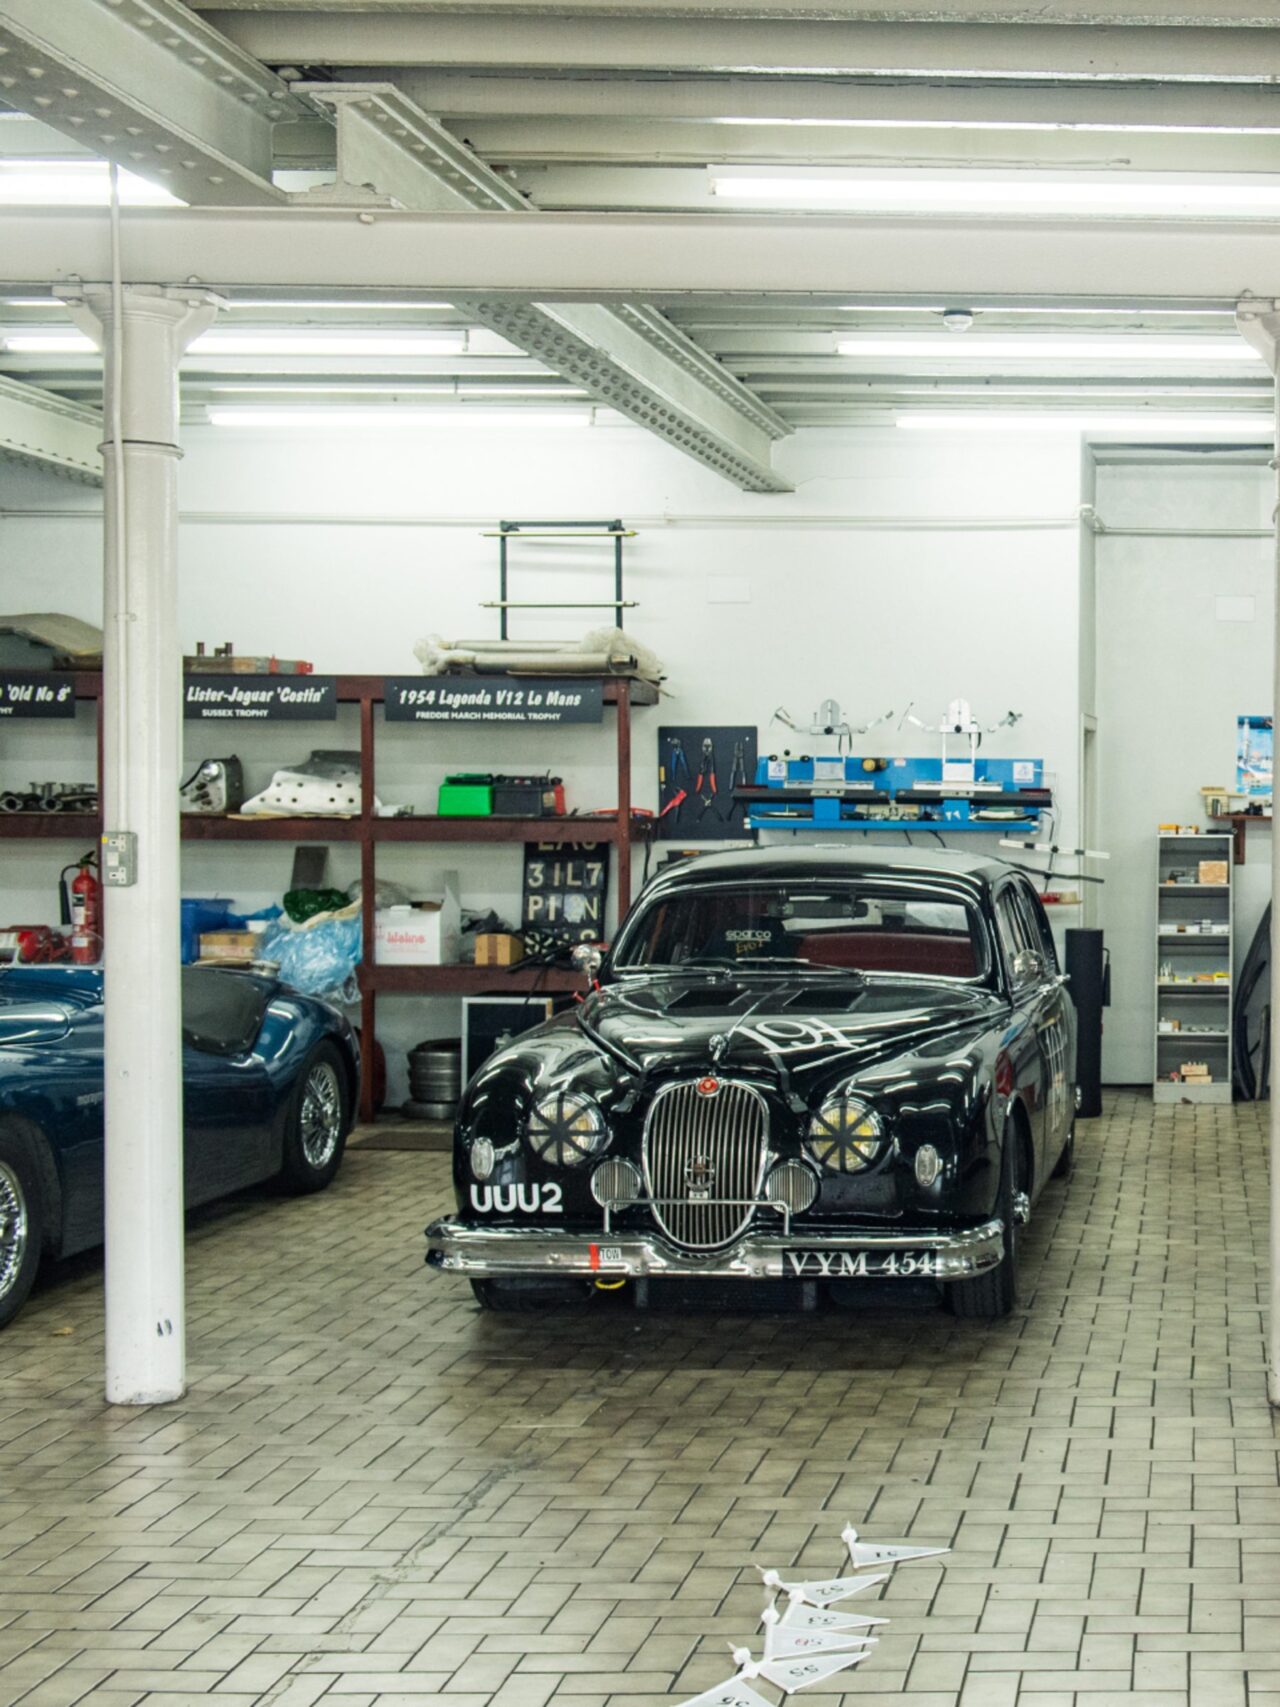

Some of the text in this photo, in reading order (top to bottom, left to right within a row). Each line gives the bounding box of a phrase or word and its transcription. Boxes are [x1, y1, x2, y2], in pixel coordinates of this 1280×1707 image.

[35, 686, 54, 702] No
[186, 686, 275, 706] Lister-Jaguar
[400, 689, 436, 705] 1954
[439, 688, 492, 709] Lagonda
[496, 689, 524, 706] V12
[546, 690, 582, 706] Mans
[202, 708, 269, 717] SUSSEX TROPHY
[415, 711, 561, 721] FREDDIE MARCH MEMORIAL TROPHY
[725, 929, 772, 941] sparco
[734, 1017, 867, 1055] 191
[601, 1248, 620, 1261] TOW
[785, 1251, 938, 1276] VYM 454
